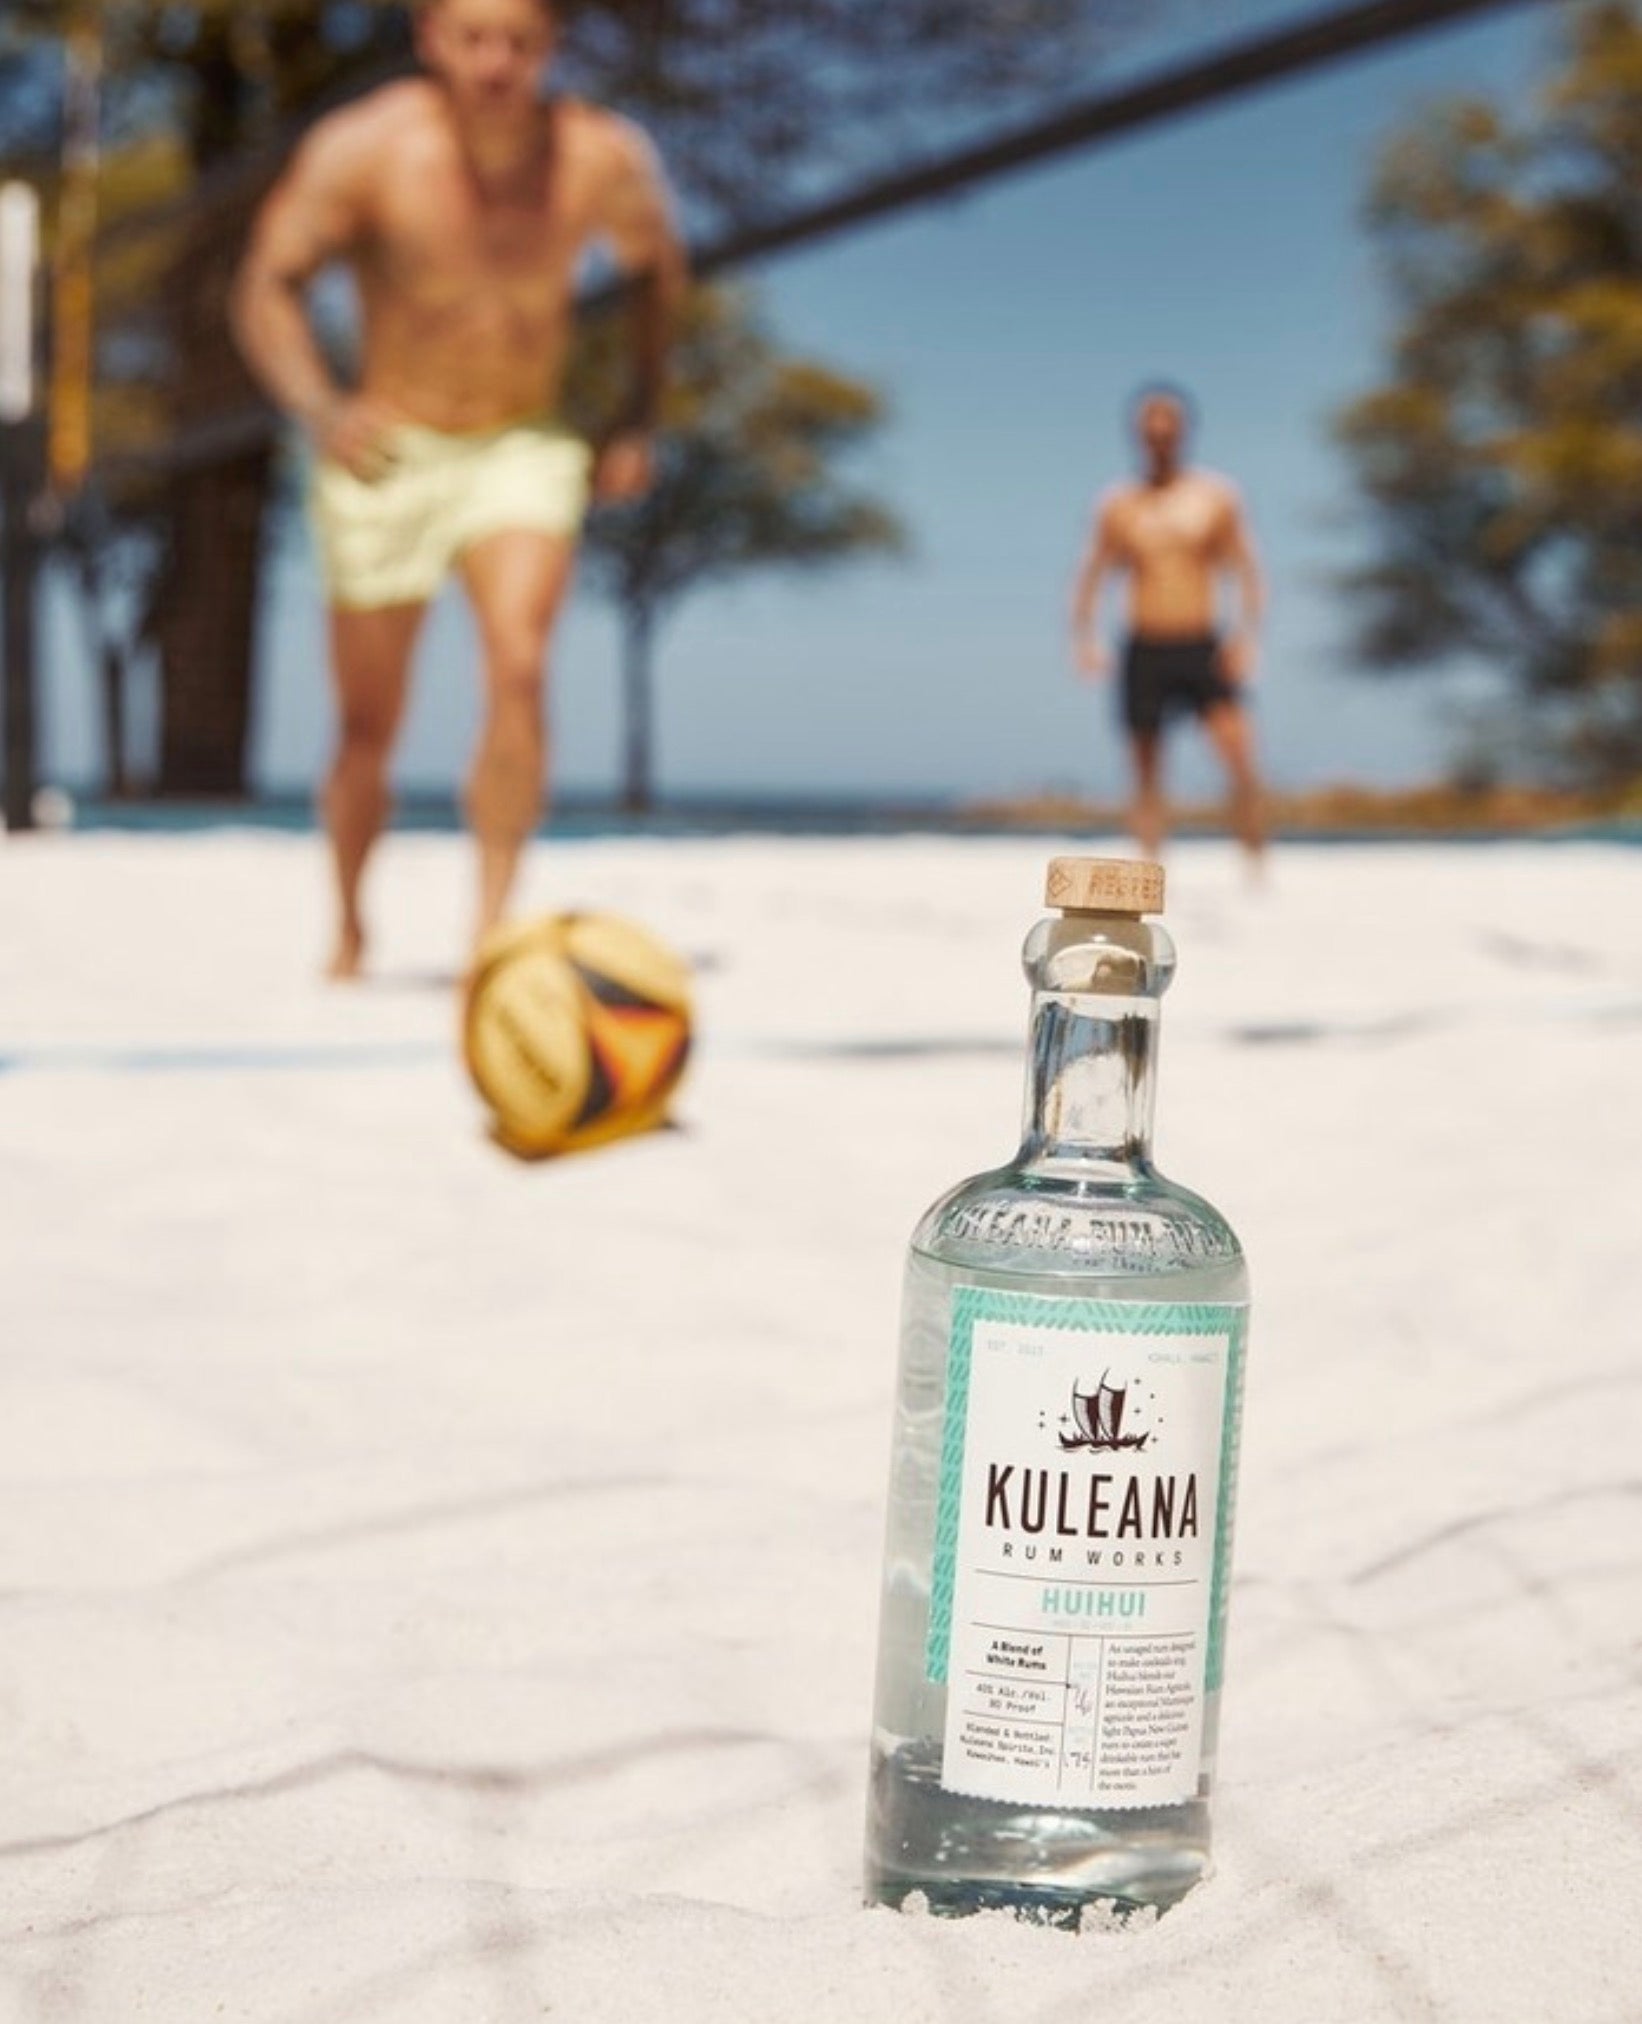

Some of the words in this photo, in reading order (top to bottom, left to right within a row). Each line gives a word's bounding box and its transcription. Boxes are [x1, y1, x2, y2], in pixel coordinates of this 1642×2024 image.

[986, 1462, 1198, 1539] KULEANA
[1002, 1542, 1063, 1562] RUM
[1087, 1550, 1183, 1567] WORKS
[1041, 1588, 1146, 1617] HUIHUI
[991, 1641, 998, 1650] A
[1001, 1641, 1029, 1654] Blend
[1031, 1645, 1044, 1656] of
[986, 1654, 1015, 1667] White
[1018, 1658, 1047, 1670] Rums
[1007, 1702, 1036, 1713] Proof
